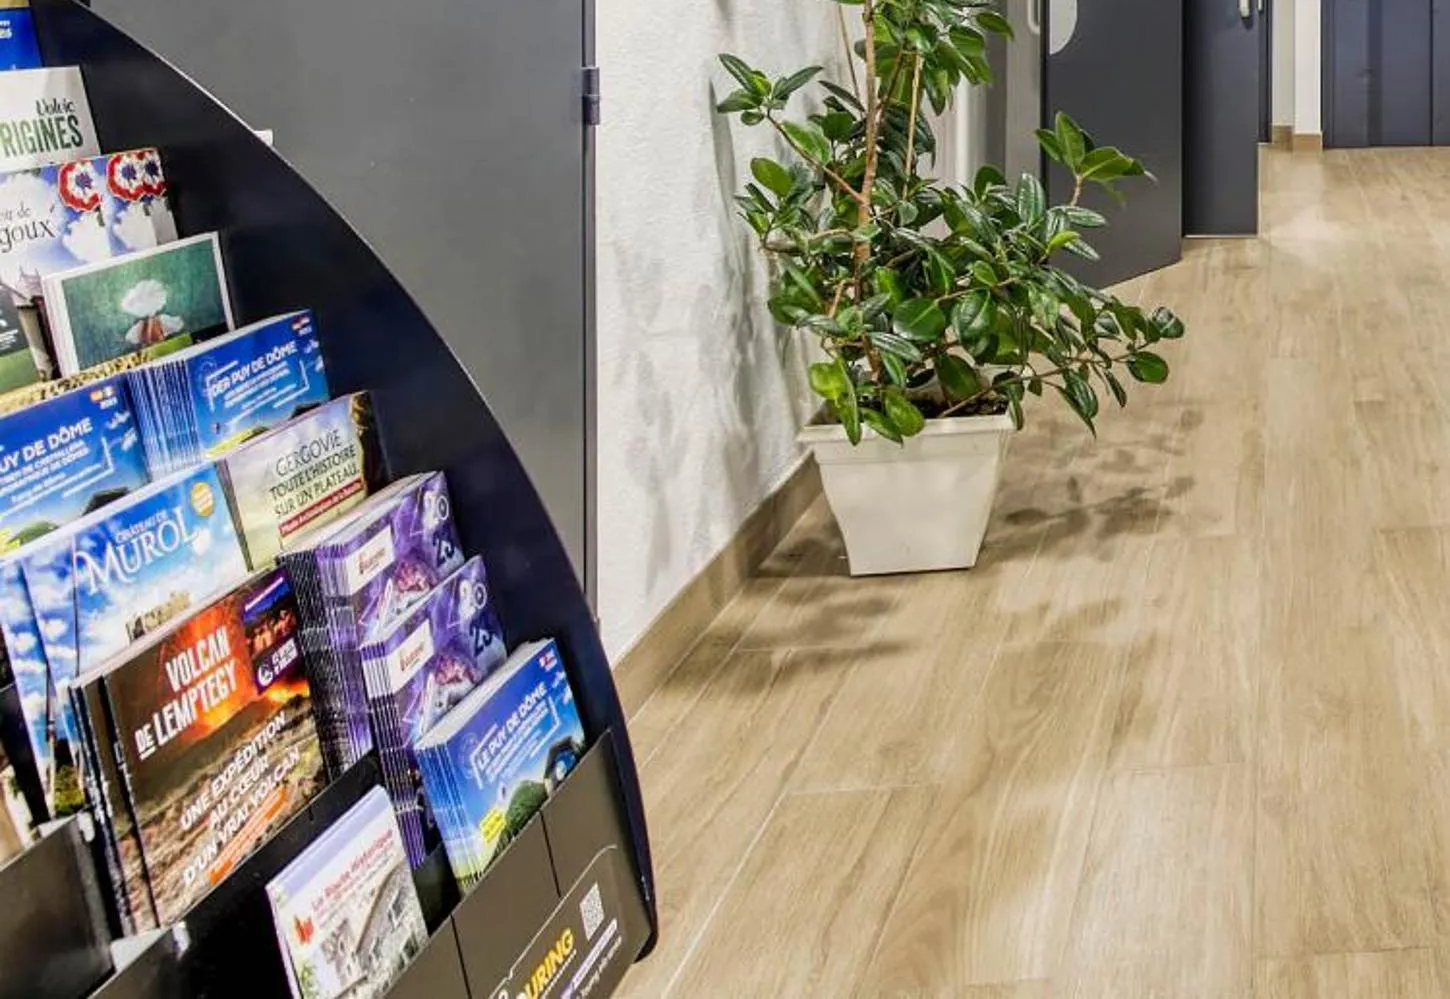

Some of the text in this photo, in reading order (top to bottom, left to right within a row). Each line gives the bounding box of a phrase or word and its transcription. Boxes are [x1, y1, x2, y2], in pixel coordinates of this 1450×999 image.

[0, 114, 84, 158] RIGINES
[0, 220, 56, 253] goux
[0, 450, 20, 474] UY
[22, 439, 47, 461] DE
[47, 416, 93, 450] DÔME
[276, 428, 342, 478] GERGOVIE
[269, 470, 306, 501] TOUTE
[75, 506, 198, 596] MUROL
[165, 625, 231, 693] VOLCAN
[135, 658, 237, 755] DE LEMPTEGY
[505, 710, 521, 735] DE
[180, 789, 211, 831] UNE
[211, 710, 286, 799] EXPÉDITION
[248, 746, 301, 810] VOLCAN
[209, 801, 229, 831] AU
